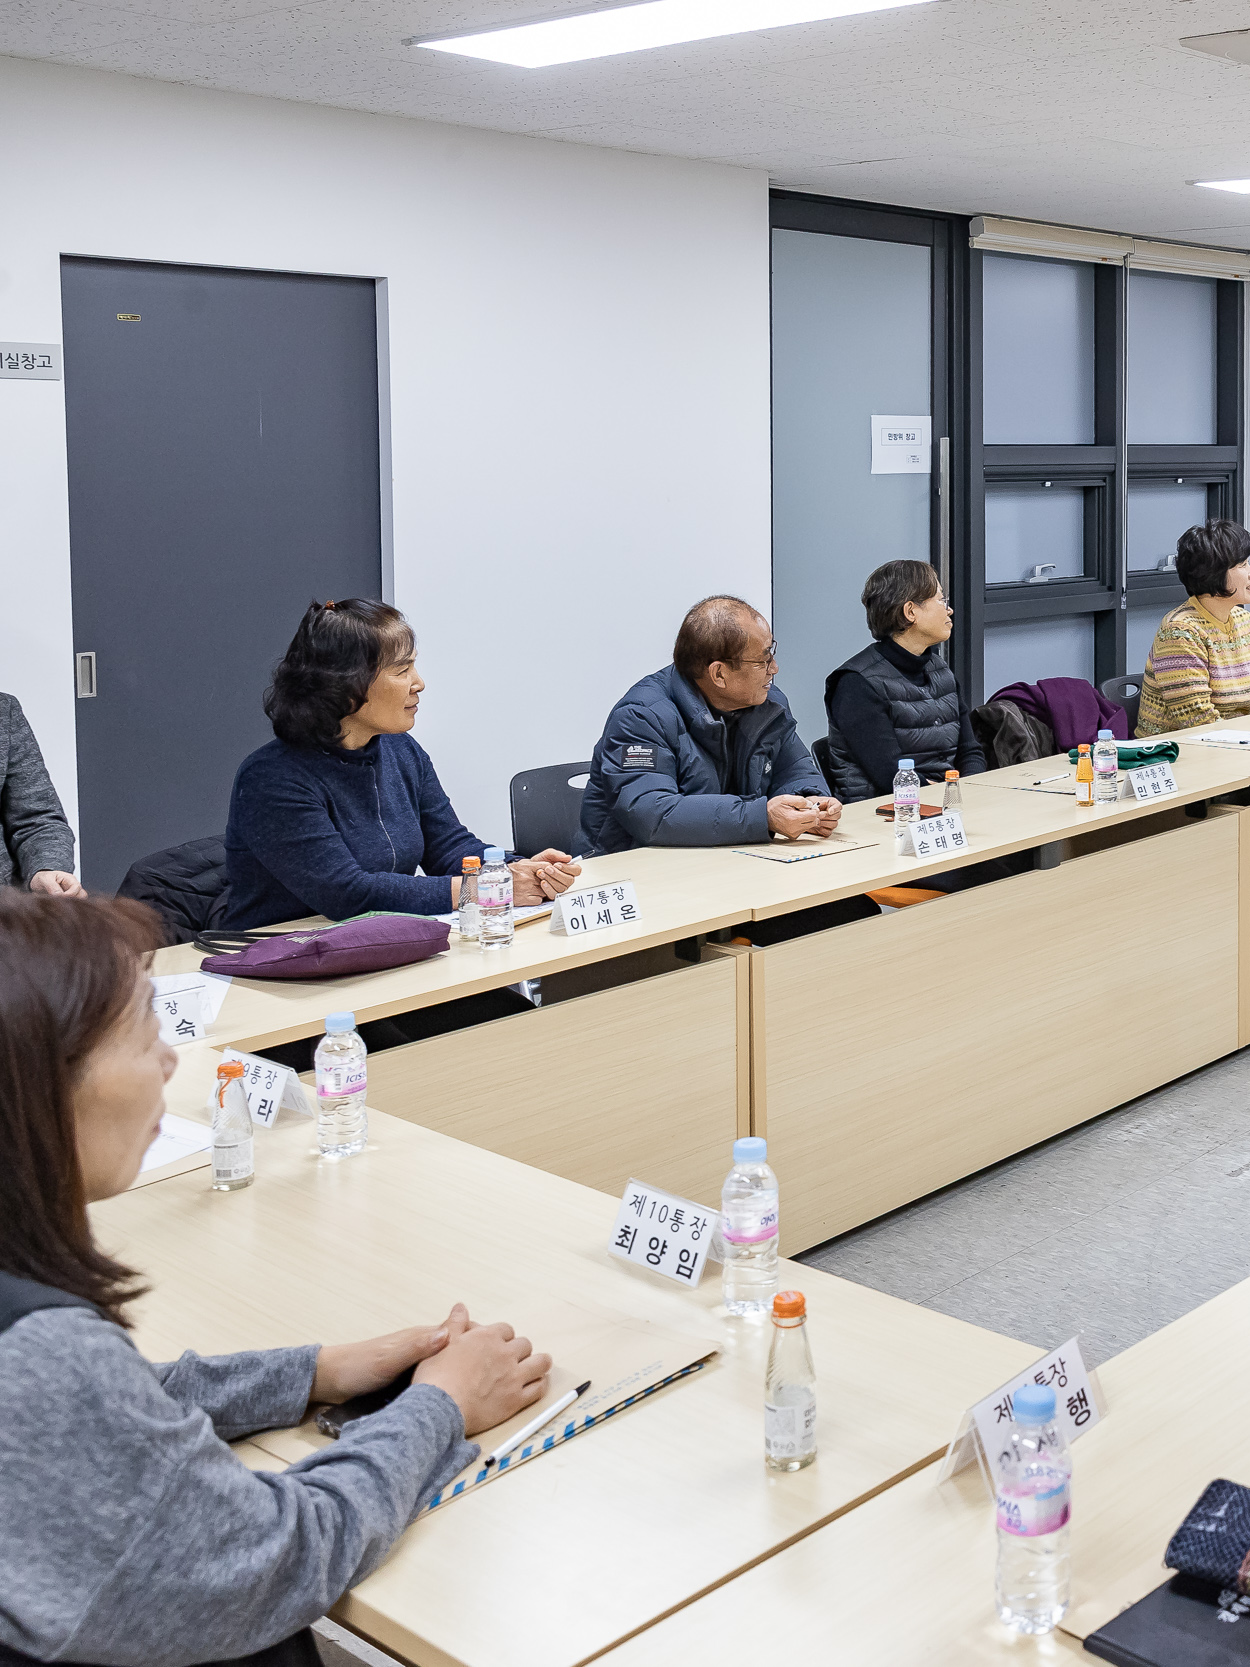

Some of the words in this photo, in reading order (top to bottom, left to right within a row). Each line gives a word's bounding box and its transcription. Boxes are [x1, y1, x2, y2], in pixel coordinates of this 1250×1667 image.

[0, 352, 53, 371] 실창고
[1135, 765, 1167, 781] 제4통장
[917, 817, 955, 835] 제5통장
[571, 886, 625, 909] 제7통장
[629, 1193, 708, 1241] 제10통장
